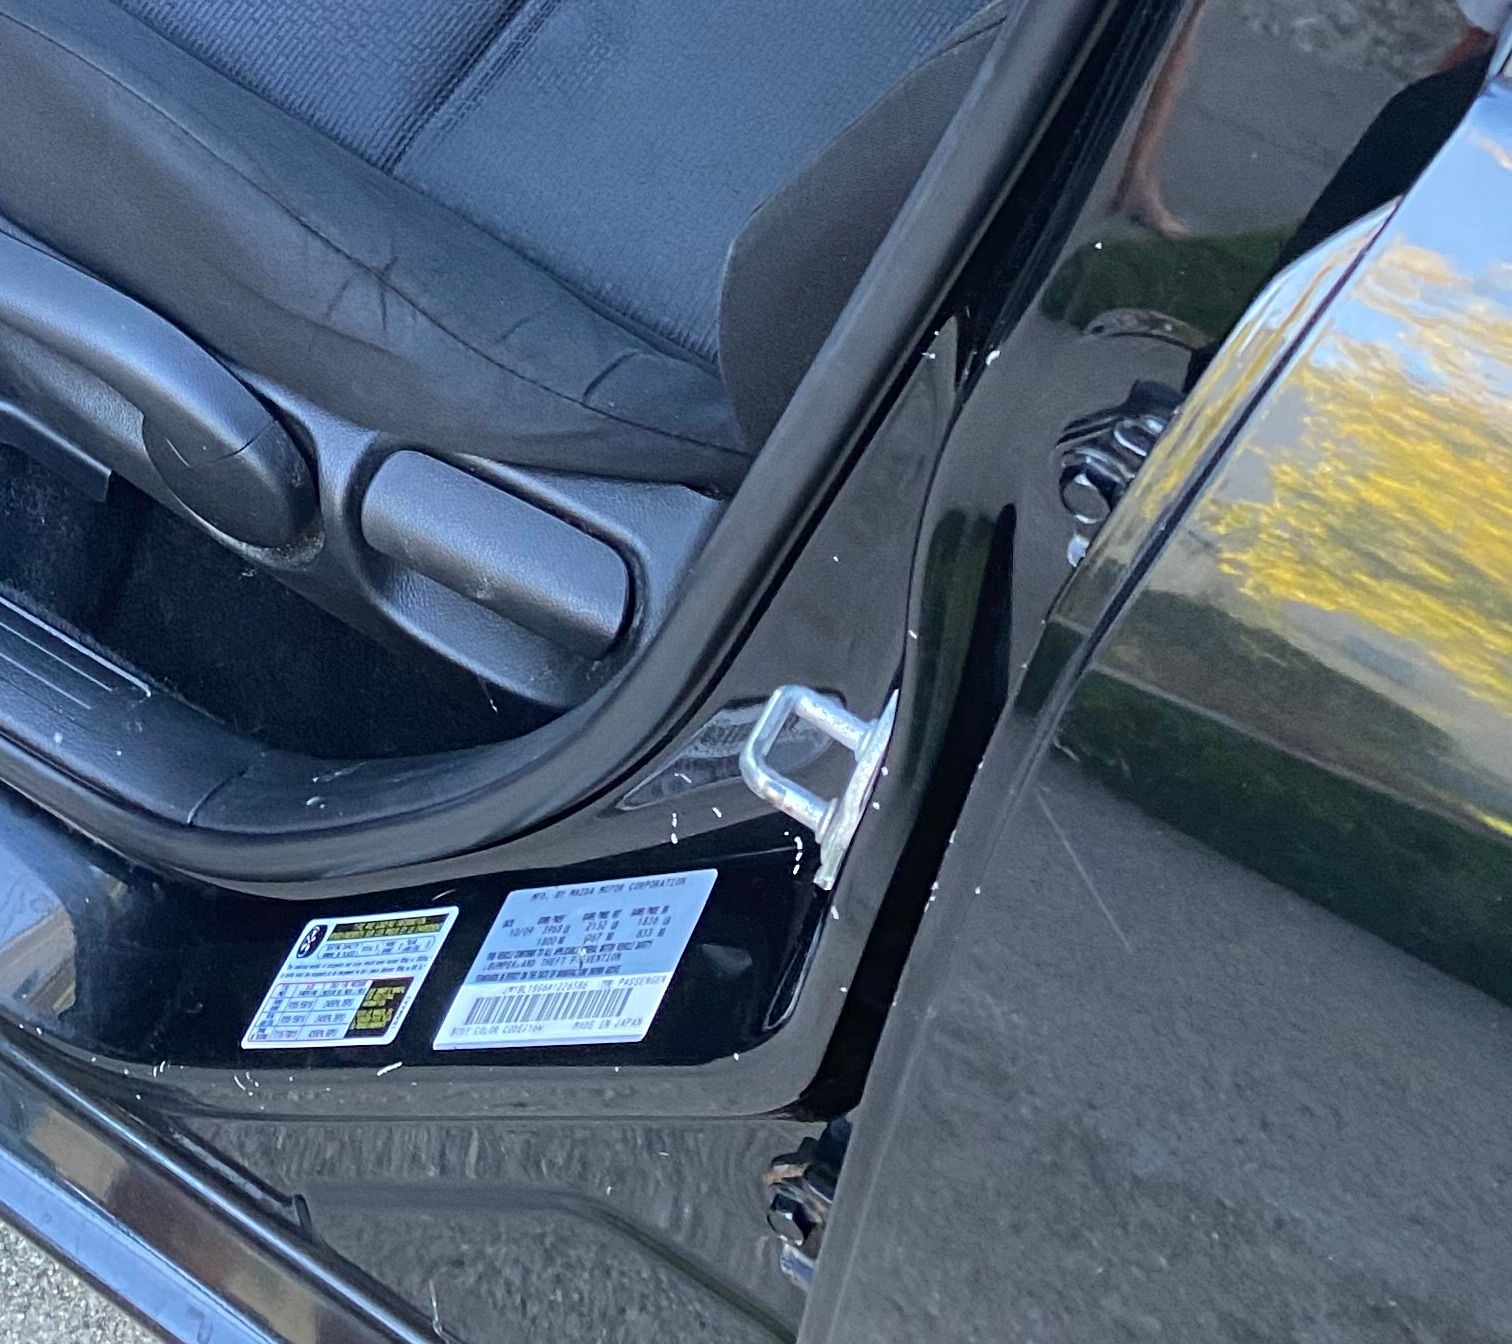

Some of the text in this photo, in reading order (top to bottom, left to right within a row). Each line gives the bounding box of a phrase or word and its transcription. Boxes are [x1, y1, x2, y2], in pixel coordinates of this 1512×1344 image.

[569, 887, 595, 896] MAZDA
[598, 884, 625, 894] MOTOR
[628, 877, 688, 891] CORPORATION
[509, 926, 535, 937] 10/09
[617, 975, 668, 987] PASSENGER
[572, 1017, 643, 1031] MADE IN JAPAN
